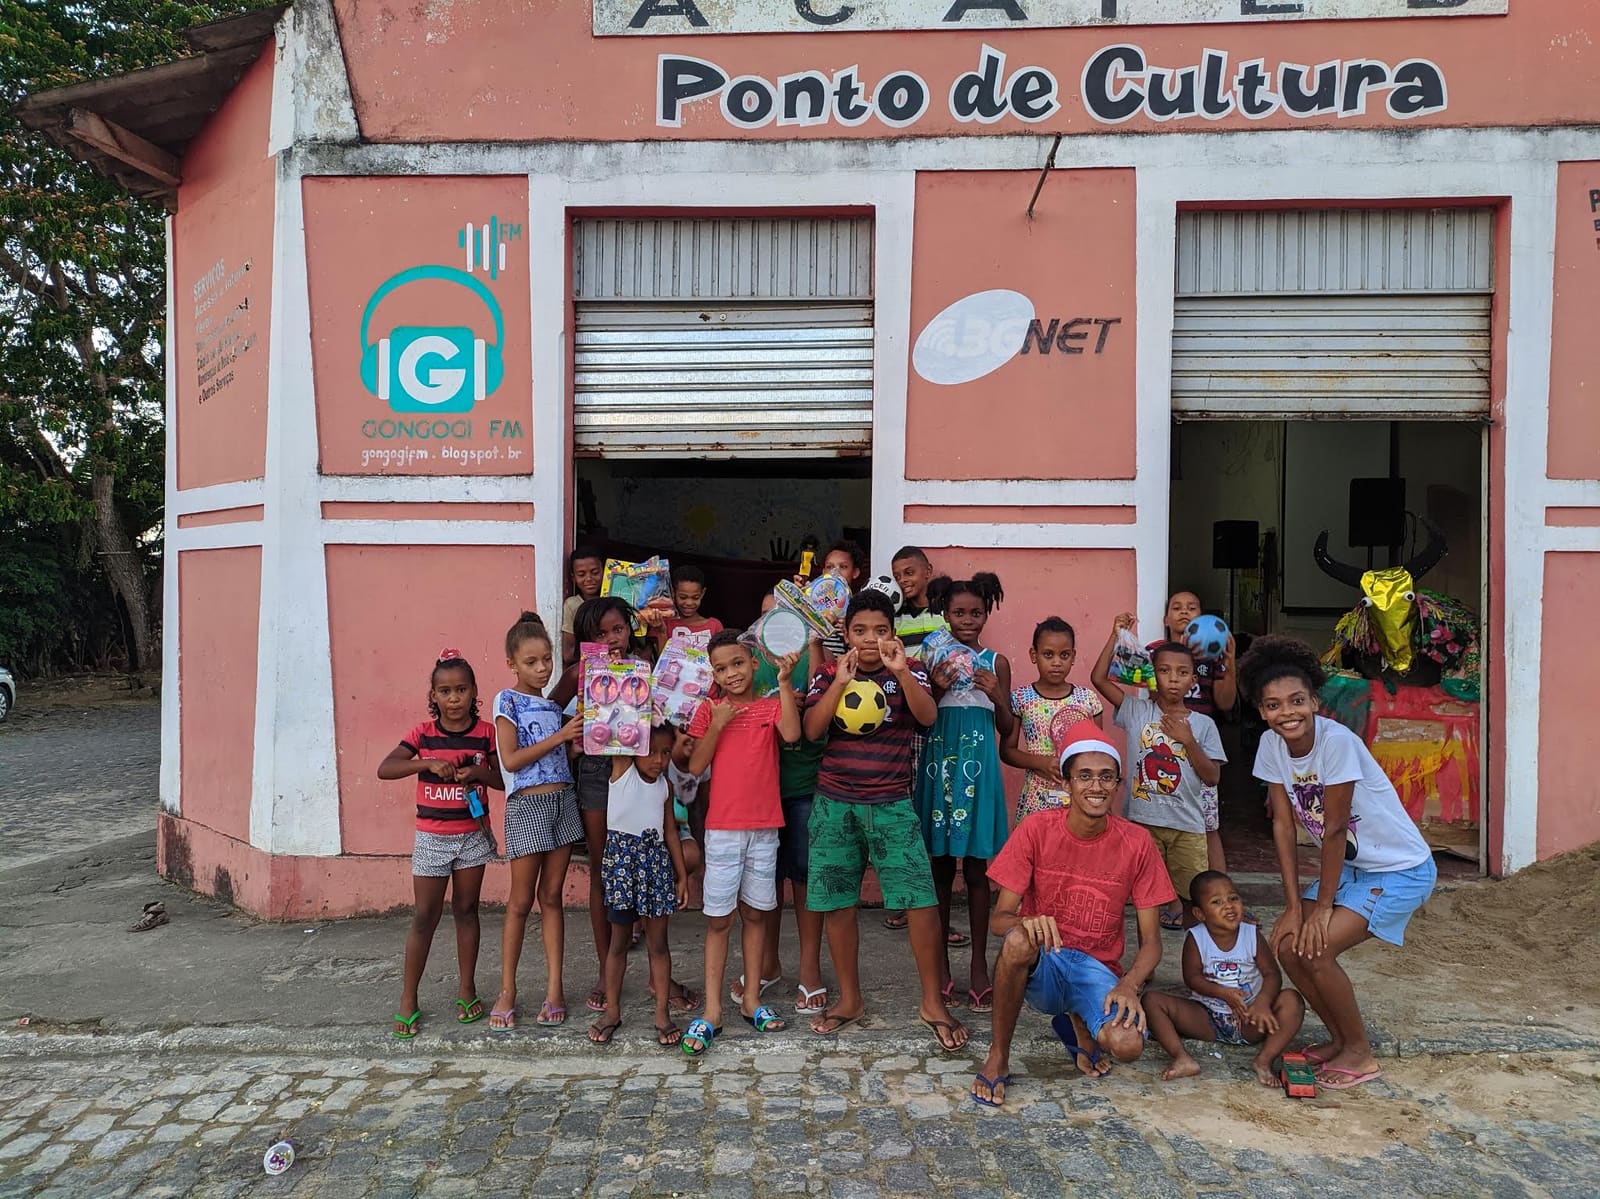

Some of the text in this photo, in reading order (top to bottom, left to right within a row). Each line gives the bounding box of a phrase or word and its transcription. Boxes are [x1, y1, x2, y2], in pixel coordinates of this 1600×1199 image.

[656, 43, 1448, 128] Ponto de Cultura
[500, 223, 521, 241] FM
[362, 420, 523, 439] GONGOGI FM
[424, 785, 484, 801] FLAMEO
